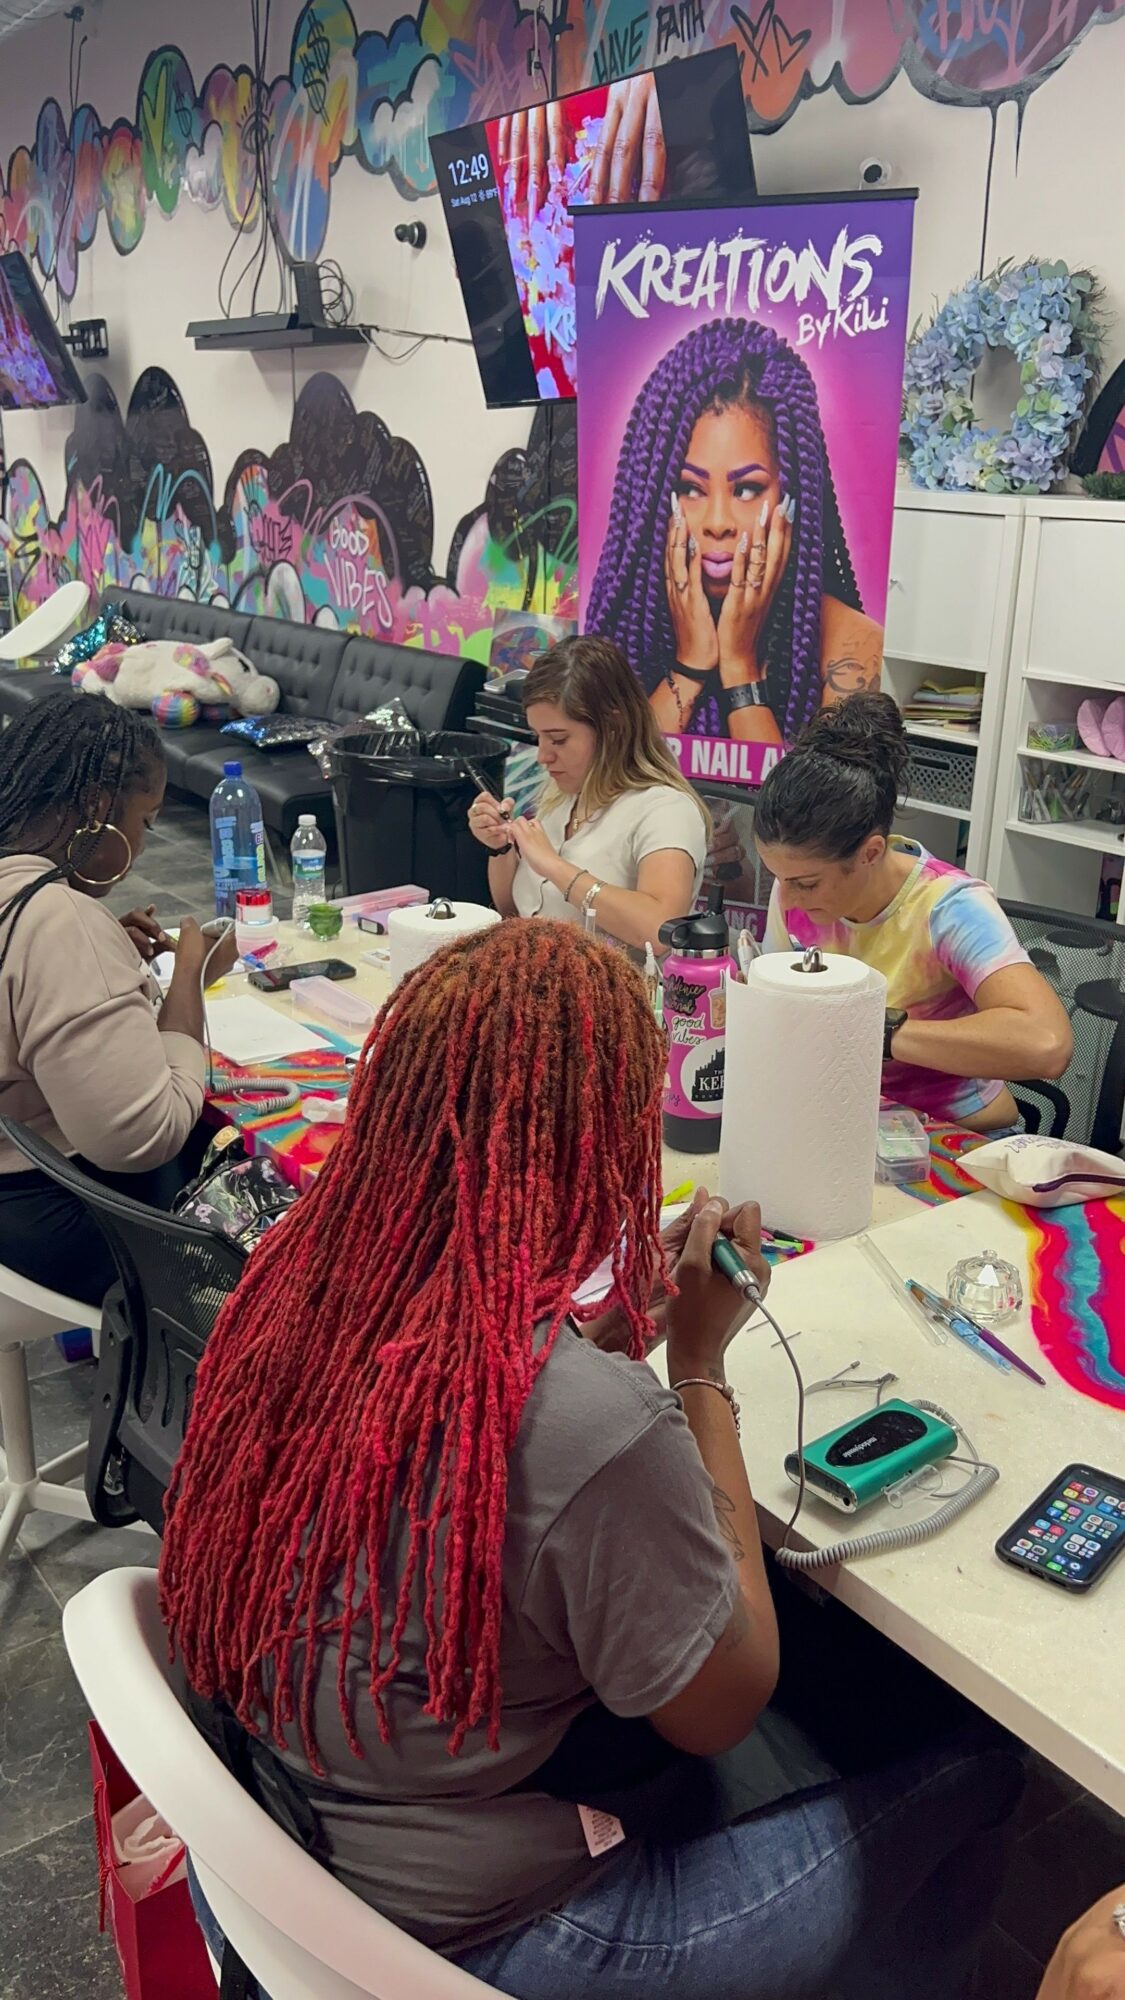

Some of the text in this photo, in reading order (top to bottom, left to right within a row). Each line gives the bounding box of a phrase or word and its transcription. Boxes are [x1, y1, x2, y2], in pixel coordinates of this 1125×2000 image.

[593, 0, 705, 83] HAVE FAITH
[447, 153, 490, 187] 12:49
[595, 225, 884, 320] KREATIONS
[795, 297, 890, 350] By Kiki
[329, 516, 370, 556] GOOD
[323, 552, 394, 629] VIBES
[691, 740, 752, 780] NAIL
[672, 1013, 705, 1031] good
[672, 1028, 706, 1046] vibes
